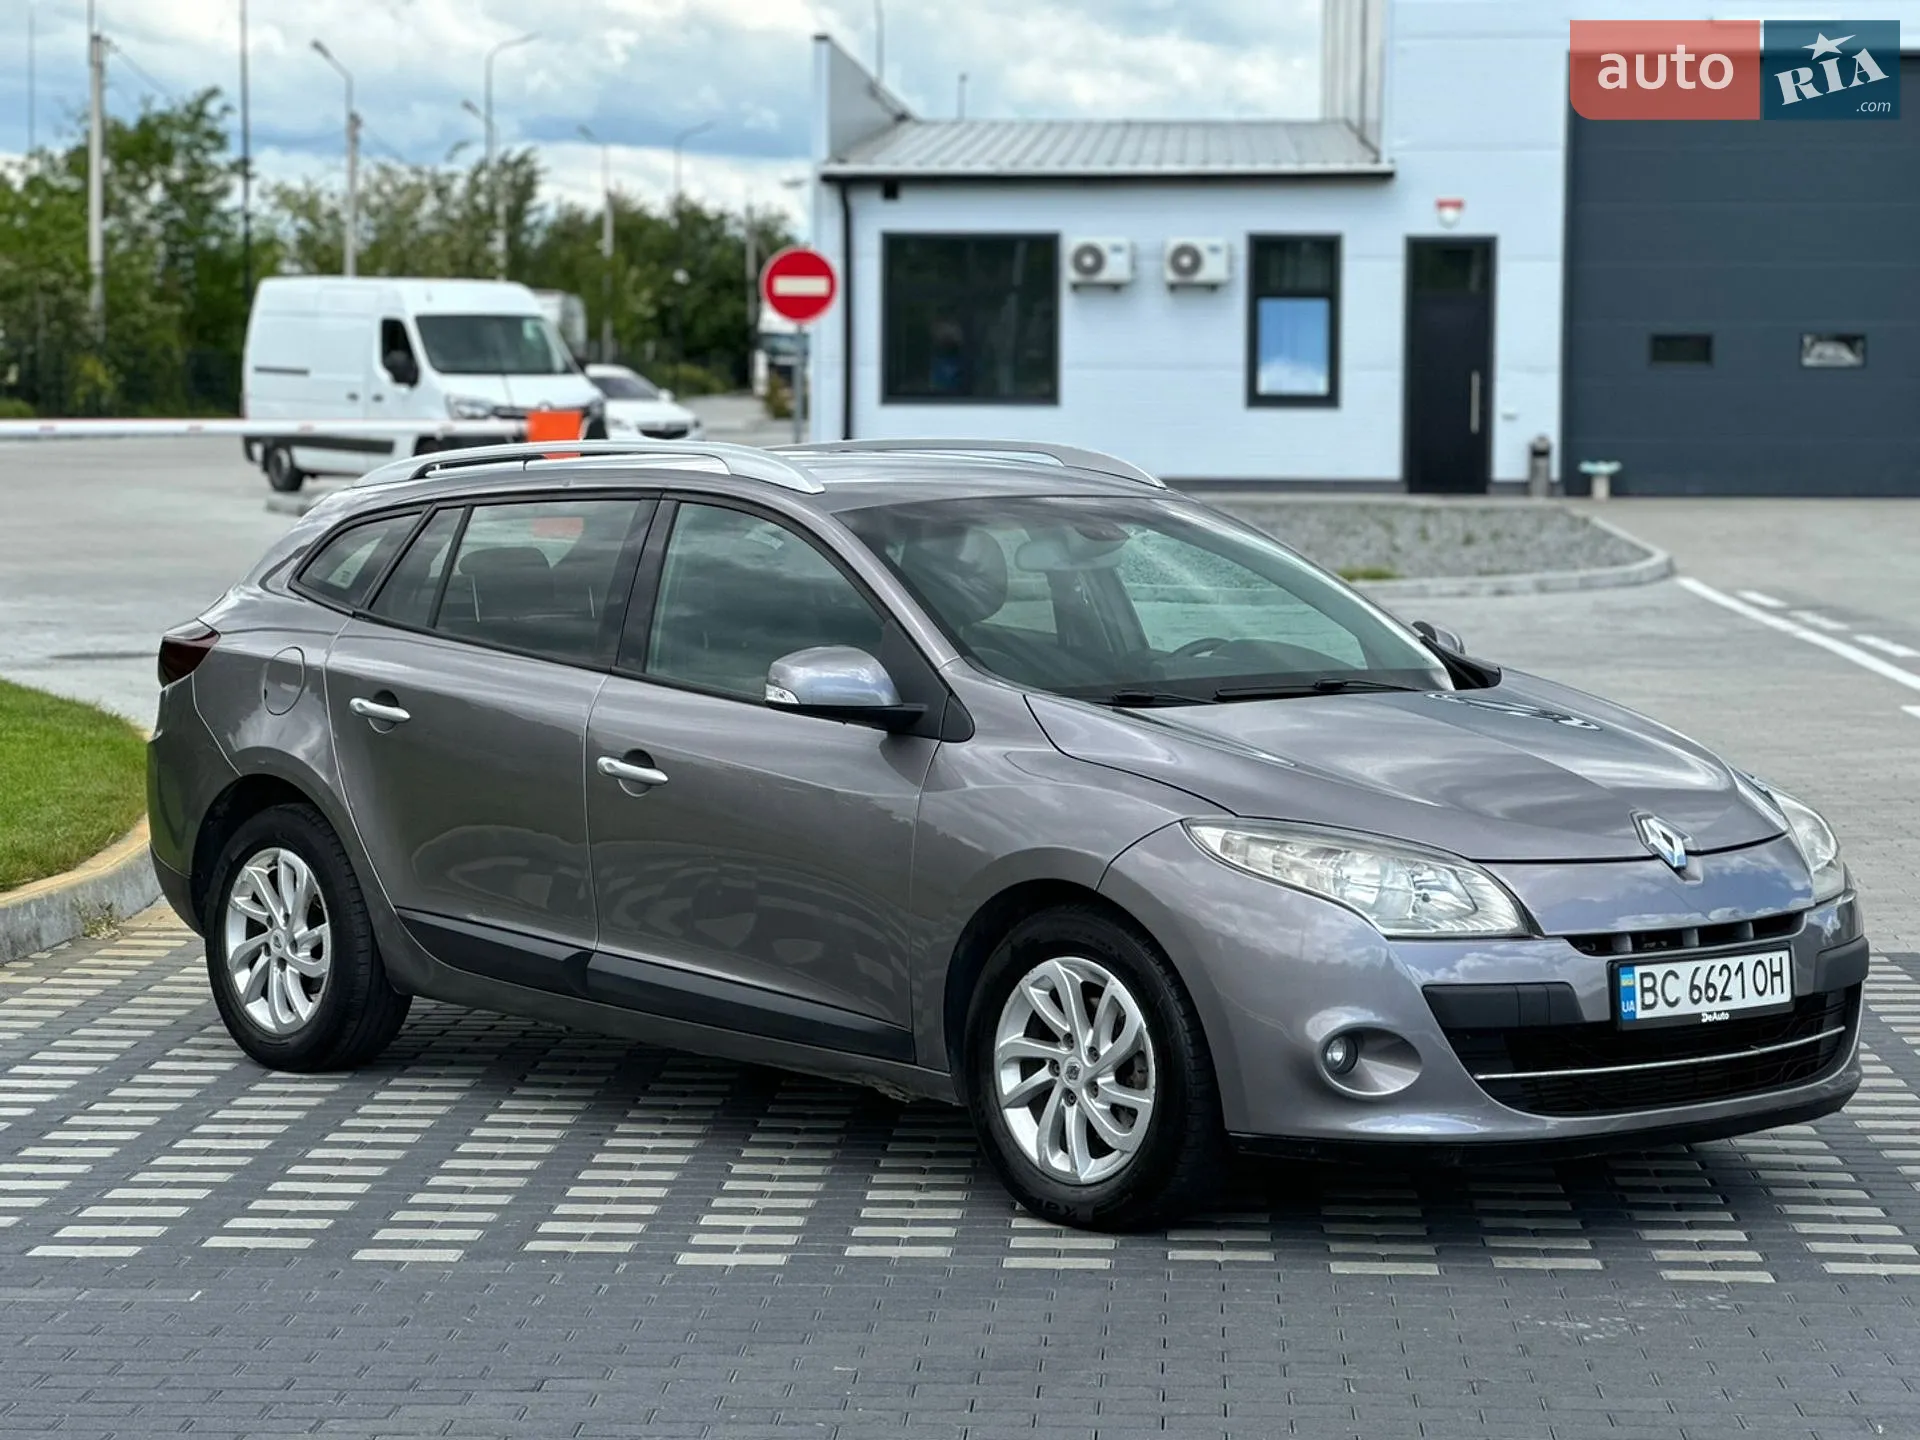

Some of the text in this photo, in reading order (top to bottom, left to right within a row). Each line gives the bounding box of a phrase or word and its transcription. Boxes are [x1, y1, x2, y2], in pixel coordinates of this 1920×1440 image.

[1640, 956, 1785, 1011] BC 6621 OH
[1622, 999, 1635, 1013] UA
